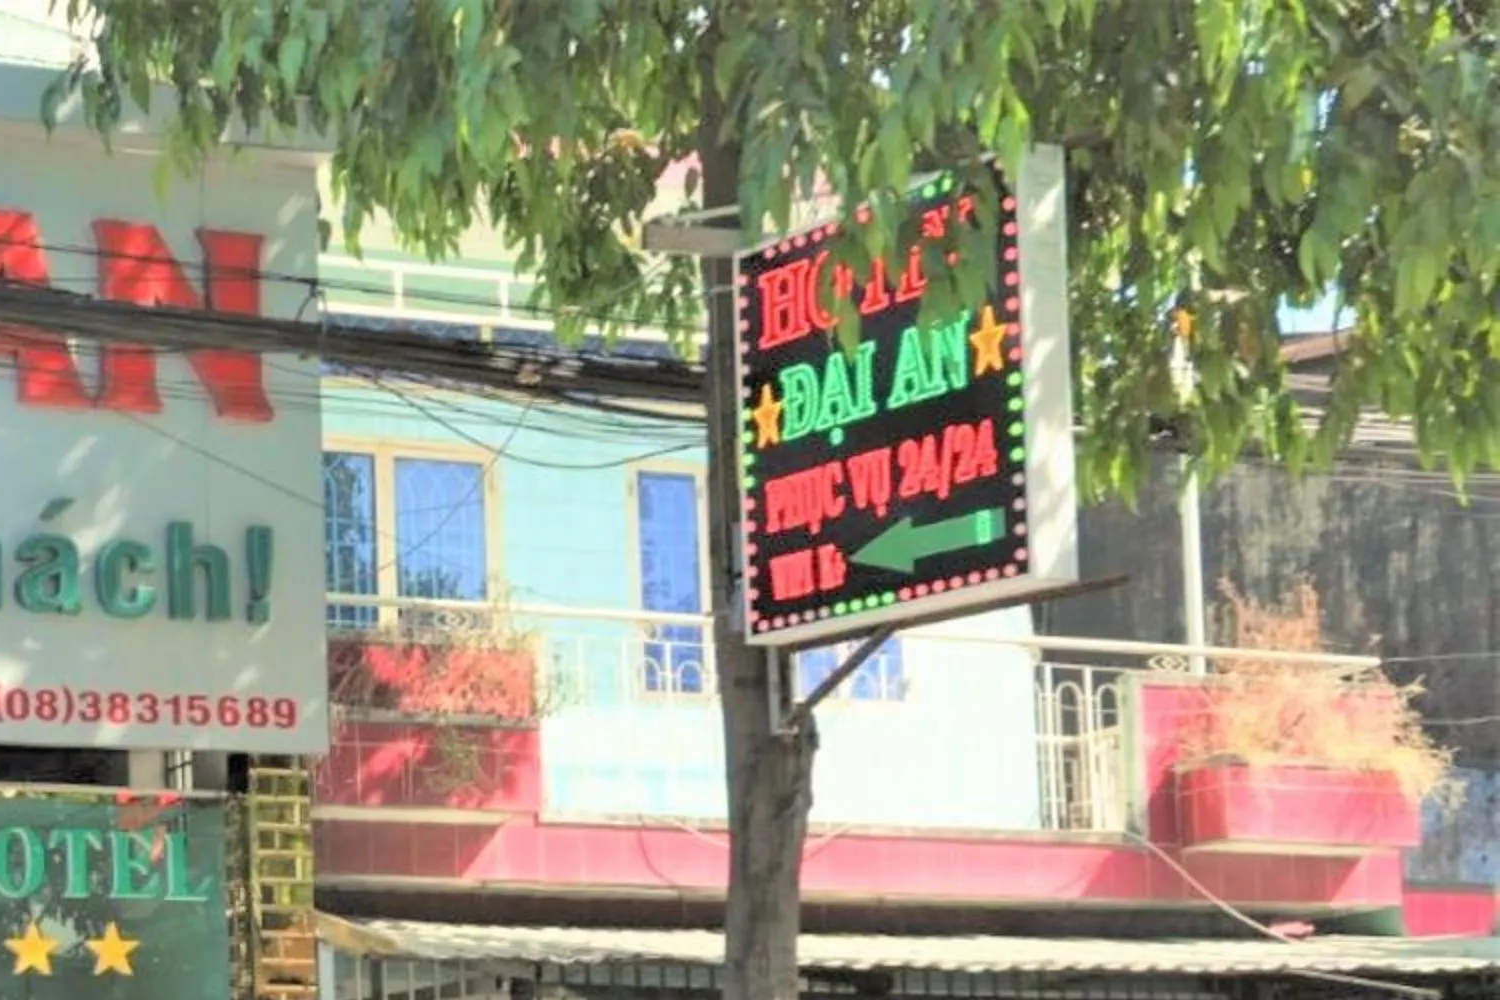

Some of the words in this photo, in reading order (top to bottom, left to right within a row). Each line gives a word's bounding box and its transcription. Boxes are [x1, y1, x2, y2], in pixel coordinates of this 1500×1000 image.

[780, 338, 878, 446] ĐẠI
[885, 308, 972, 411] AN
[896, 416, 999, 500] 24/24
